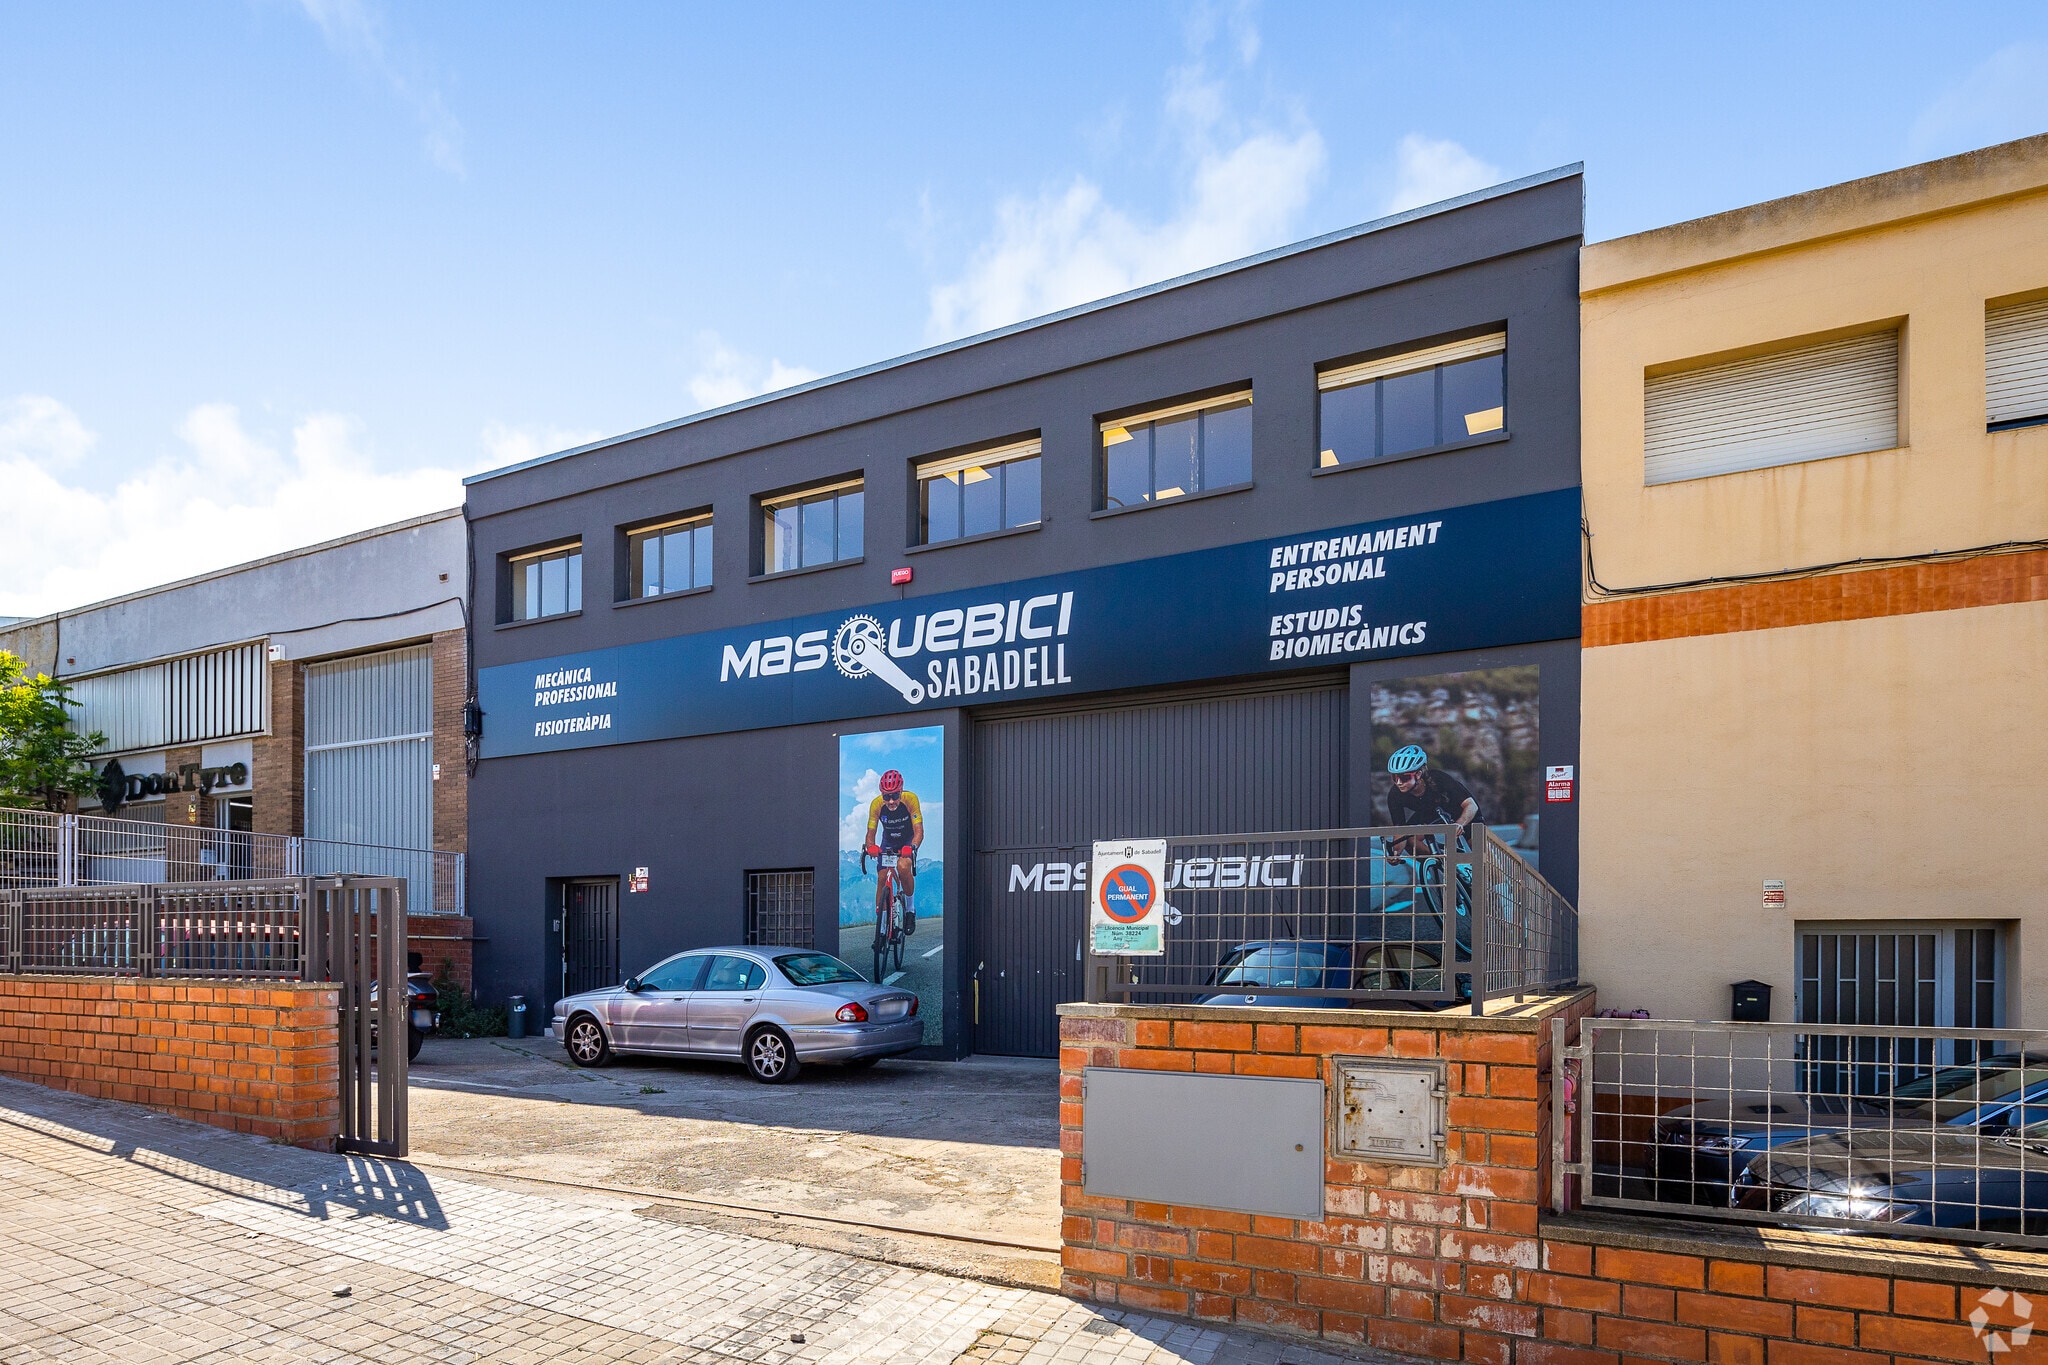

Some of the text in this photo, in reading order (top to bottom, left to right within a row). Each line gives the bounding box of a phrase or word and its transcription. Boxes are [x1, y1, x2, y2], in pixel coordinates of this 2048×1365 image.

[1270, 521, 1442, 568] ENTRENAMENT
[1270, 557, 1386, 593] PERSONAL
[1270, 604, 1363, 636] ESTUDIS
[1269, 621, 1427, 661] BIOMECÀNICS
[534, 667, 591, 690] MECÀNICA
[927, 643, 1072, 698] SABADELL
[534, 681, 617, 707] PROFESSIONAL
[534, 712, 611, 737] FISIOTERÀPIA
[1107, 893, 1149, 901] PERMANENT
